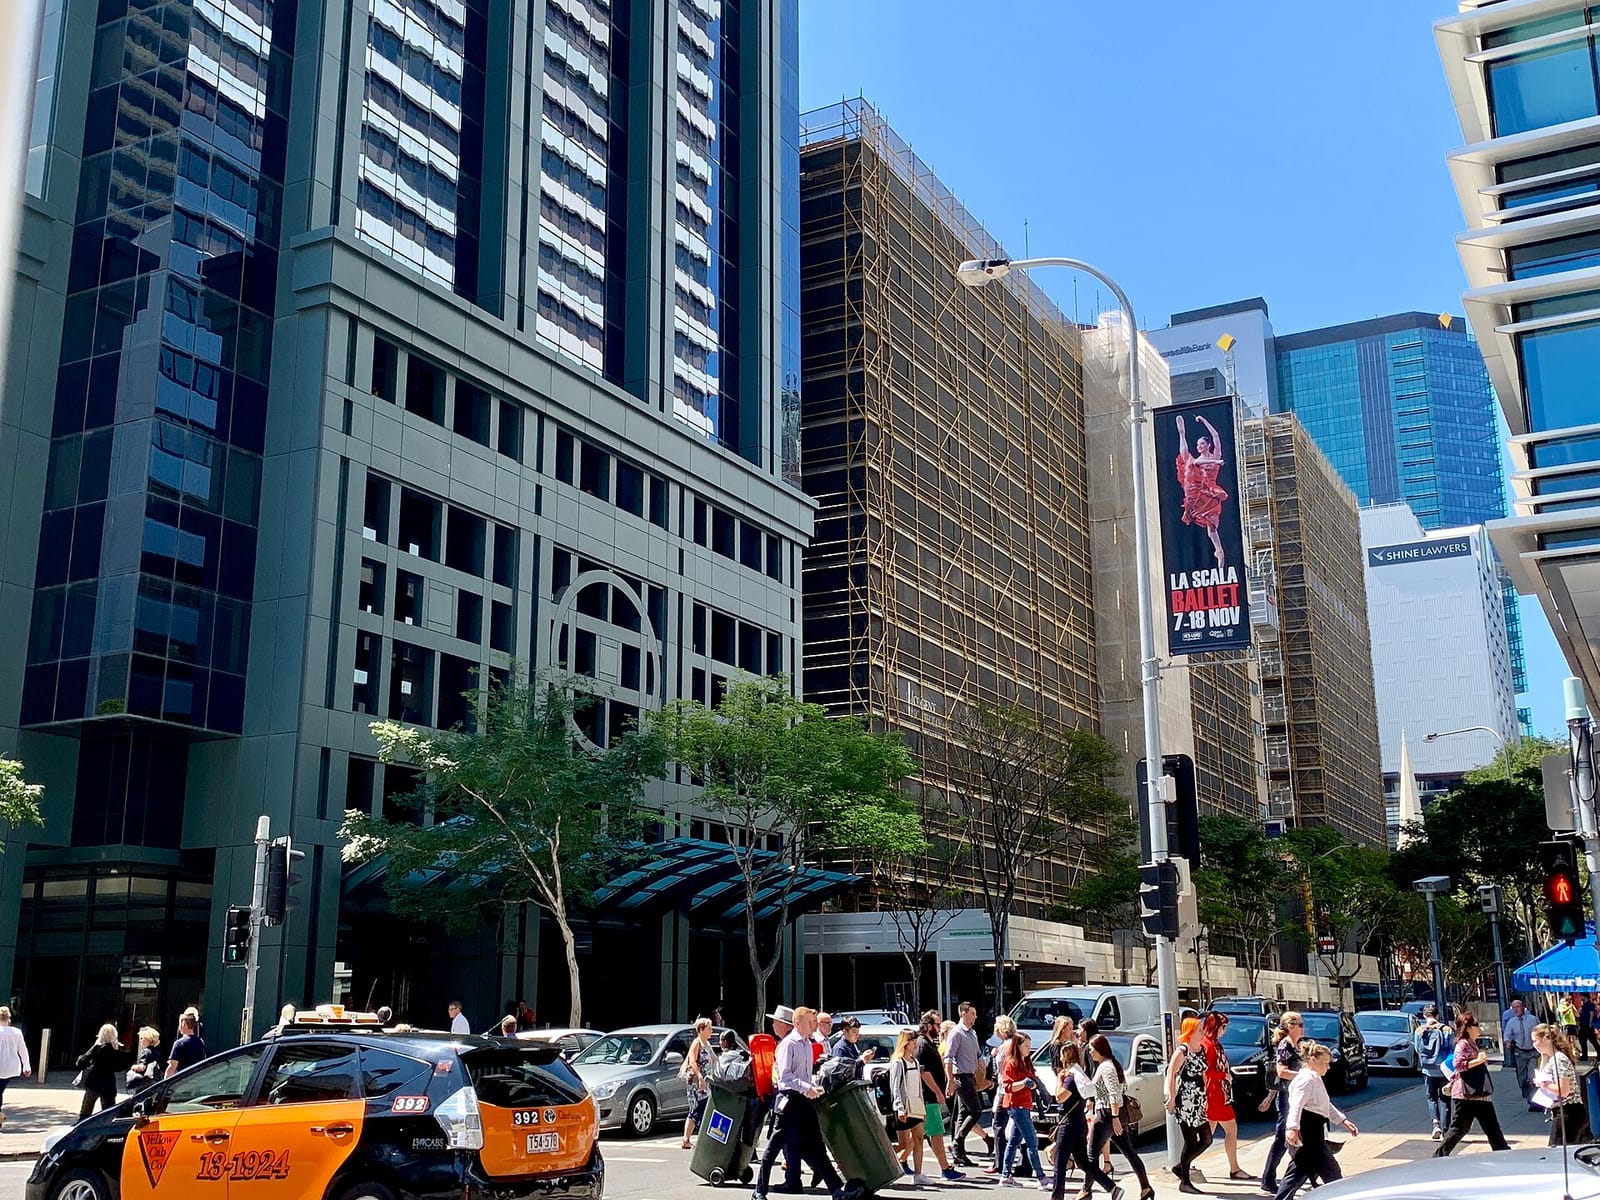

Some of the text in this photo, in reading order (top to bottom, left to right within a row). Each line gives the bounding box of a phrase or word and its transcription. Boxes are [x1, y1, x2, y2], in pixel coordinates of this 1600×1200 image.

[1386, 542, 1467, 561] SHINE LAWYERS
[1170, 566, 1239, 591] LA SCALA
[1171, 583, 1240, 614] BALLET
[1173, 606, 1241, 632] 7-18 NOV
[394, 1098, 425, 1111] 392
[514, 1111, 539, 1126] 392
[150, 1148, 166, 1158] Cab
[150, 1160, 163, 1170] Co
[197, 1149, 290, 1181] 13-1924
